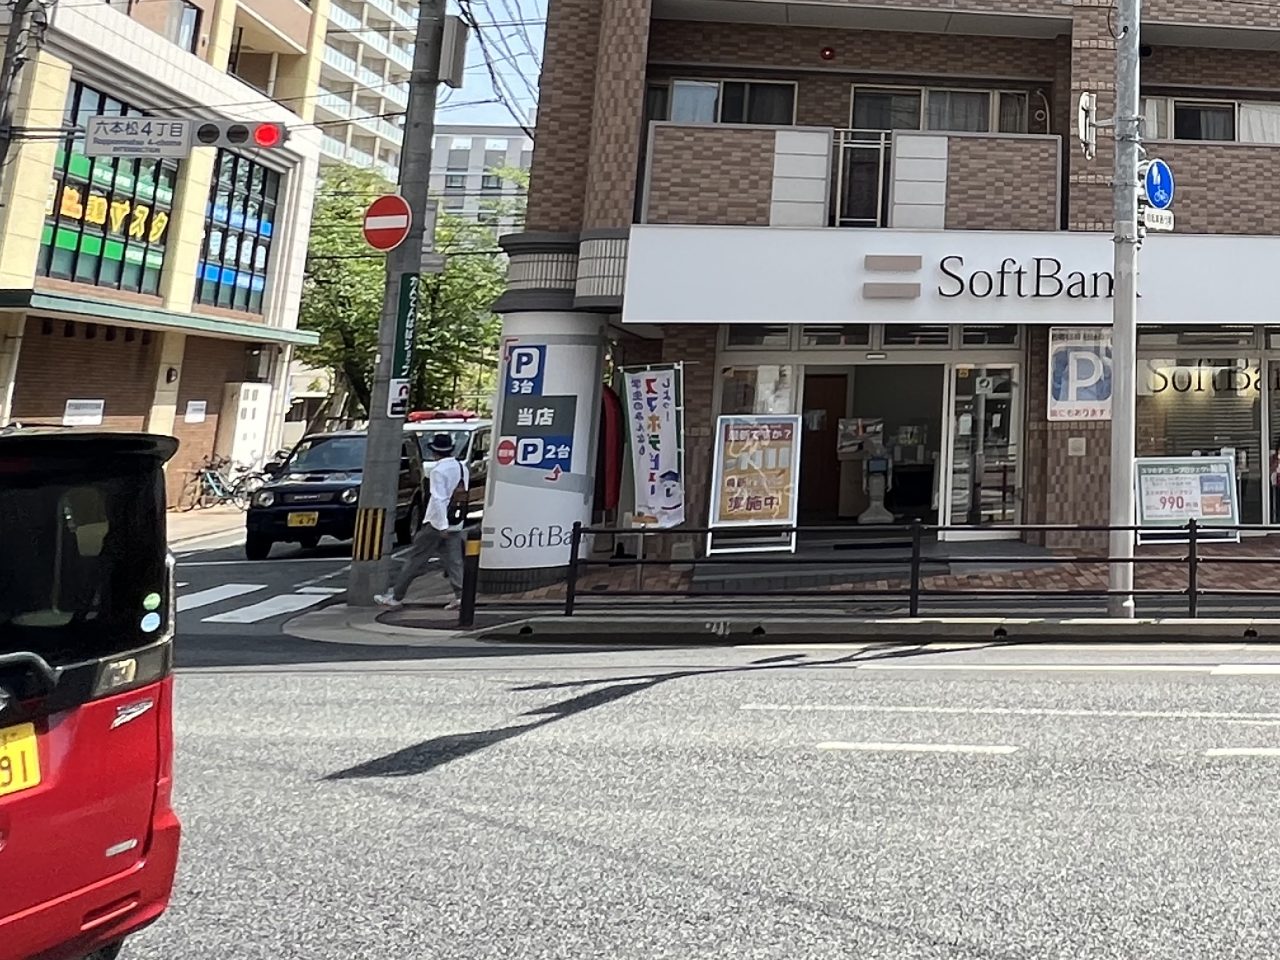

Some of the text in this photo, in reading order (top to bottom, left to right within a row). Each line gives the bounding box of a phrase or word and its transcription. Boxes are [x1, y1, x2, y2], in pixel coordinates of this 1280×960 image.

[94, 121, 183, 138] 六本松4丁目
[938, 255, 1141, 299] SoftBan
[511, 380, 534, 394] 3台
[517, 408, 554, 426] 当店
[545, 444, 570, 459] 2台
[499, 525, 590, 549] SoftBa
